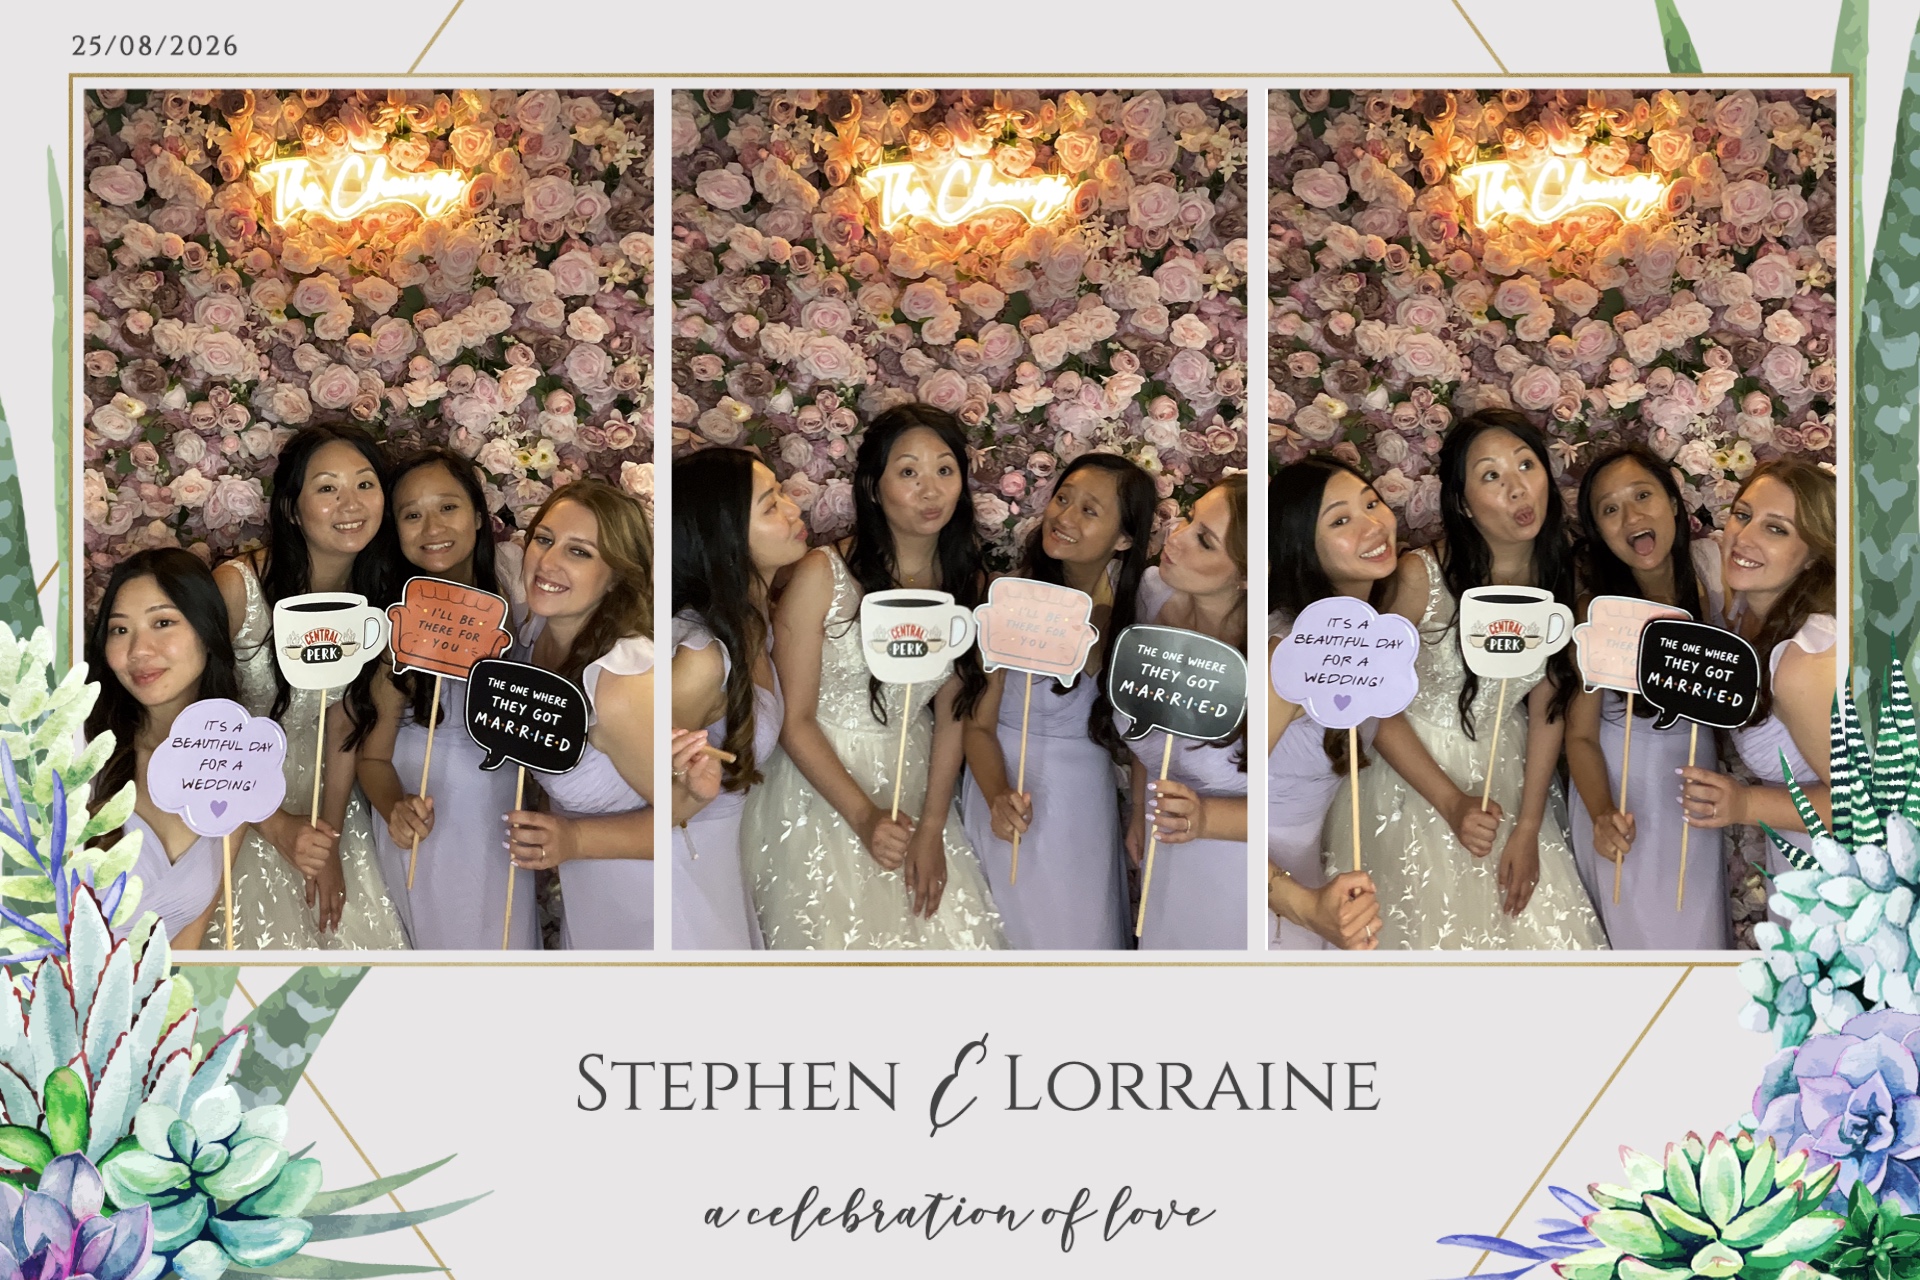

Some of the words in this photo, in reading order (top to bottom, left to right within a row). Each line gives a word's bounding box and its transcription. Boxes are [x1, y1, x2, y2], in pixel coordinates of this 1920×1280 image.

[260, 160, 324, 220] The
[866, 165, 930, 225] The
[1462, 163, 1524, 224] The
[431, 607, 453, 622] I'LL
[459, 614, 475, 626] BE
[418, 620, 454, 636] THERE
[458, 630, 480, 642] FOR
[890, 624, 924, 640] CENTRAL
[1358, 620, 1369, 629] A
[1488, 620, 1522, 636] CENTRAL
[304, 629, 339, 644] CENTRAL
[1294, 634, 1370, 648] BEAUTIFUL
[1376, 638, 1404, 649] DAY
[1490, 638, 1520, 650] PERK
[432, 638, 460, 652] YOU
[892, 642, 923, 656] PERK
[1660, 637, 1678, 650] THE
[1682, 643, 1700, 655] ONE
[1704, 648, 1740, 664] WHERE
[306, 648, 338, 661] PERK
[1138, 644, 1158, 656] THE
[1162, 651, 1184, 662] ONE
[1188, 657, 1227, 674] WHERE
[1322, 654, 1352, 667] FOR
[1357, 657, 1369, 666] A
[1664, 655, 1699, 674] THEY
[1705, 666, 1734, 682] GOT
[1141, 663, 1180, 682] THEY
[1186, 675, 1219, 692] GOT
[1304, 672, 1384, 687] WEDDING!
[488, 677, 505, 690] THE
[510, 684, 528, 696] ONE
[532, 691, 568, 708] WHERE
[492, 696, 528, 716] THEY
[533, 709, 562, 726] GOT
[232, 723, 242, 732] A
[172, 738, 243, 752] BEAUTIFUL
[248, 742, 274, 752] DAY
[199, 759, 227, 771] FOR
[232, 760, 242, 770] A
[182, 778, 256, 791] WEDDING!
